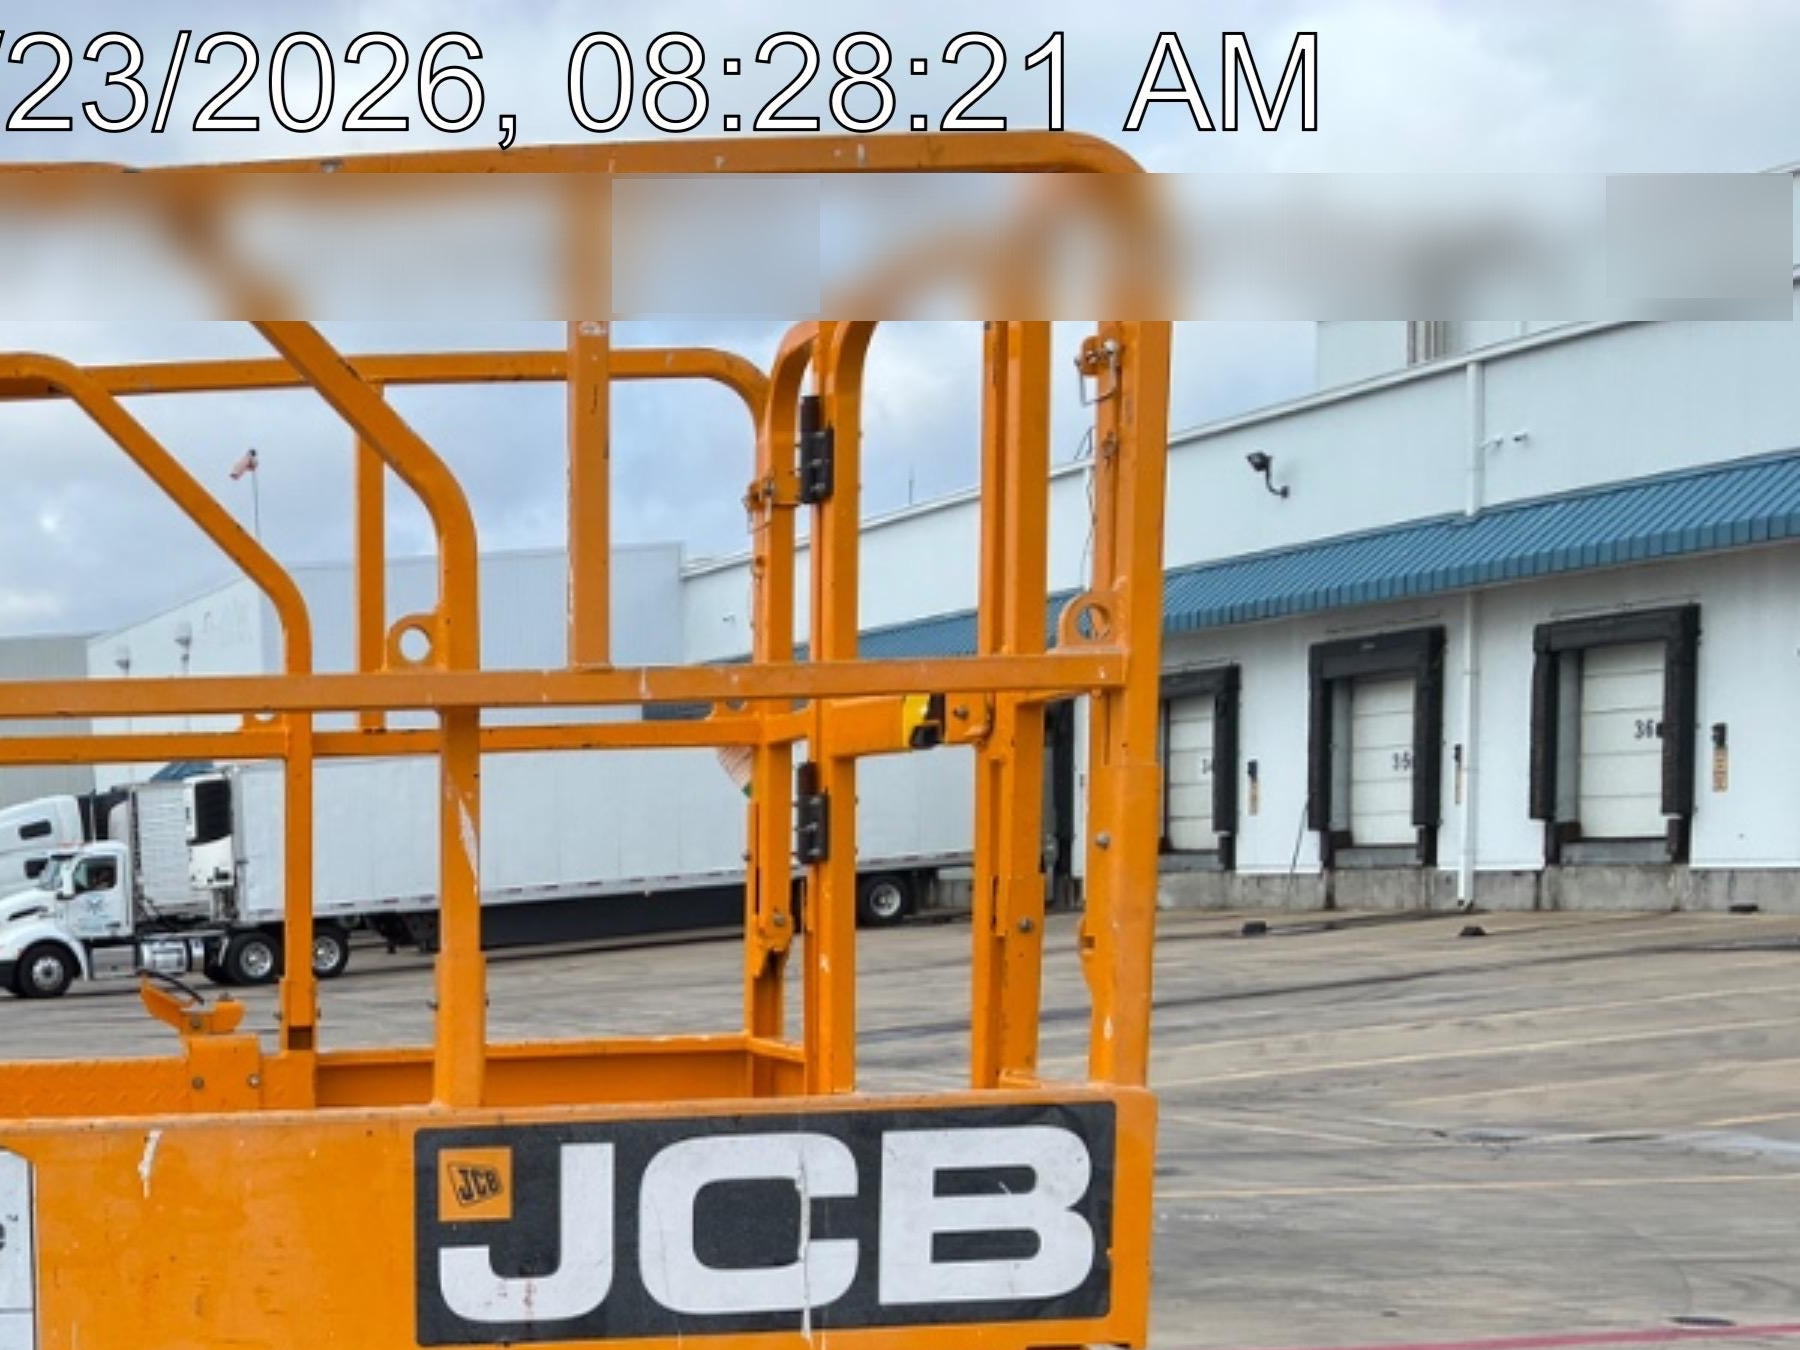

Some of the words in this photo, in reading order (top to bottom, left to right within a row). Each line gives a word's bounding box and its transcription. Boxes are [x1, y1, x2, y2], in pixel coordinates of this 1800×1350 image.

[1634, 719, 1655, 739] 36
[458, 1168, 501, 1201] JCB
[438, 1126, 1095, 1323] JCB
